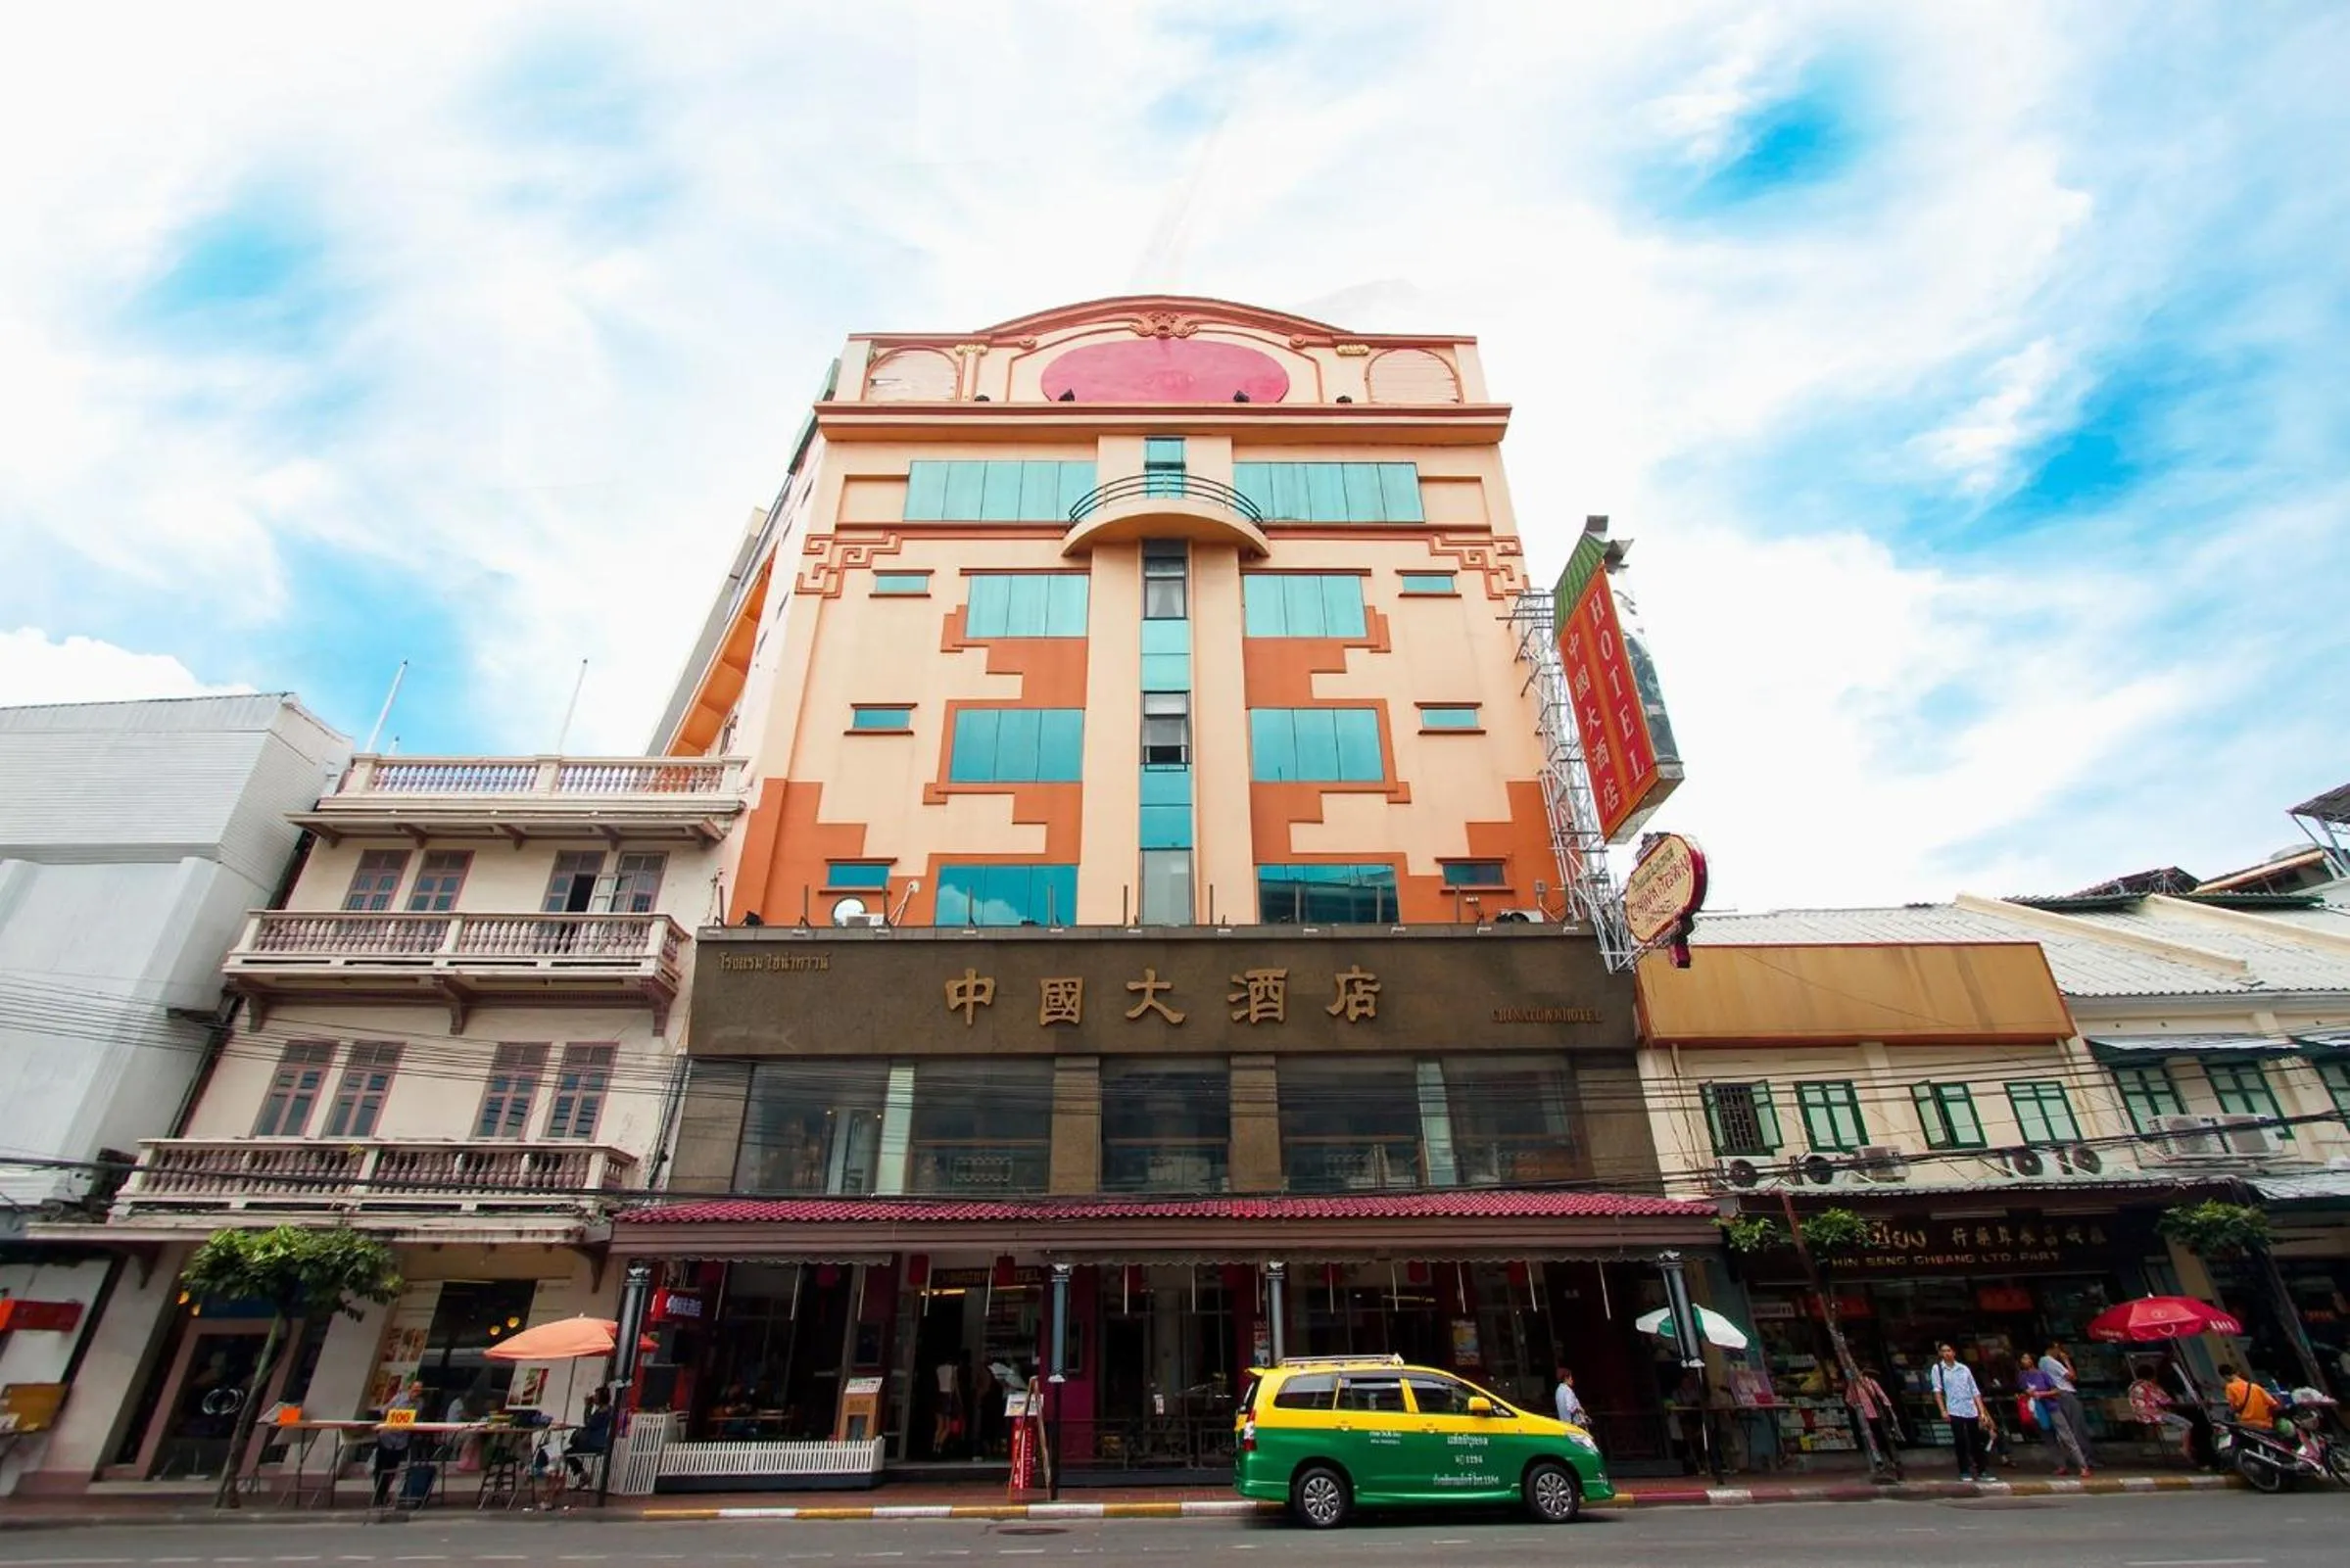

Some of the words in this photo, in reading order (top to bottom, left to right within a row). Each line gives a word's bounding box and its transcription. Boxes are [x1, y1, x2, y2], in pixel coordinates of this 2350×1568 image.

[1567, 631, 1619, 817] 中國大酒店
[1589, 588, 1646, 784] HOTEL
[944, 966, 1382, 1026] 中國大酒店
